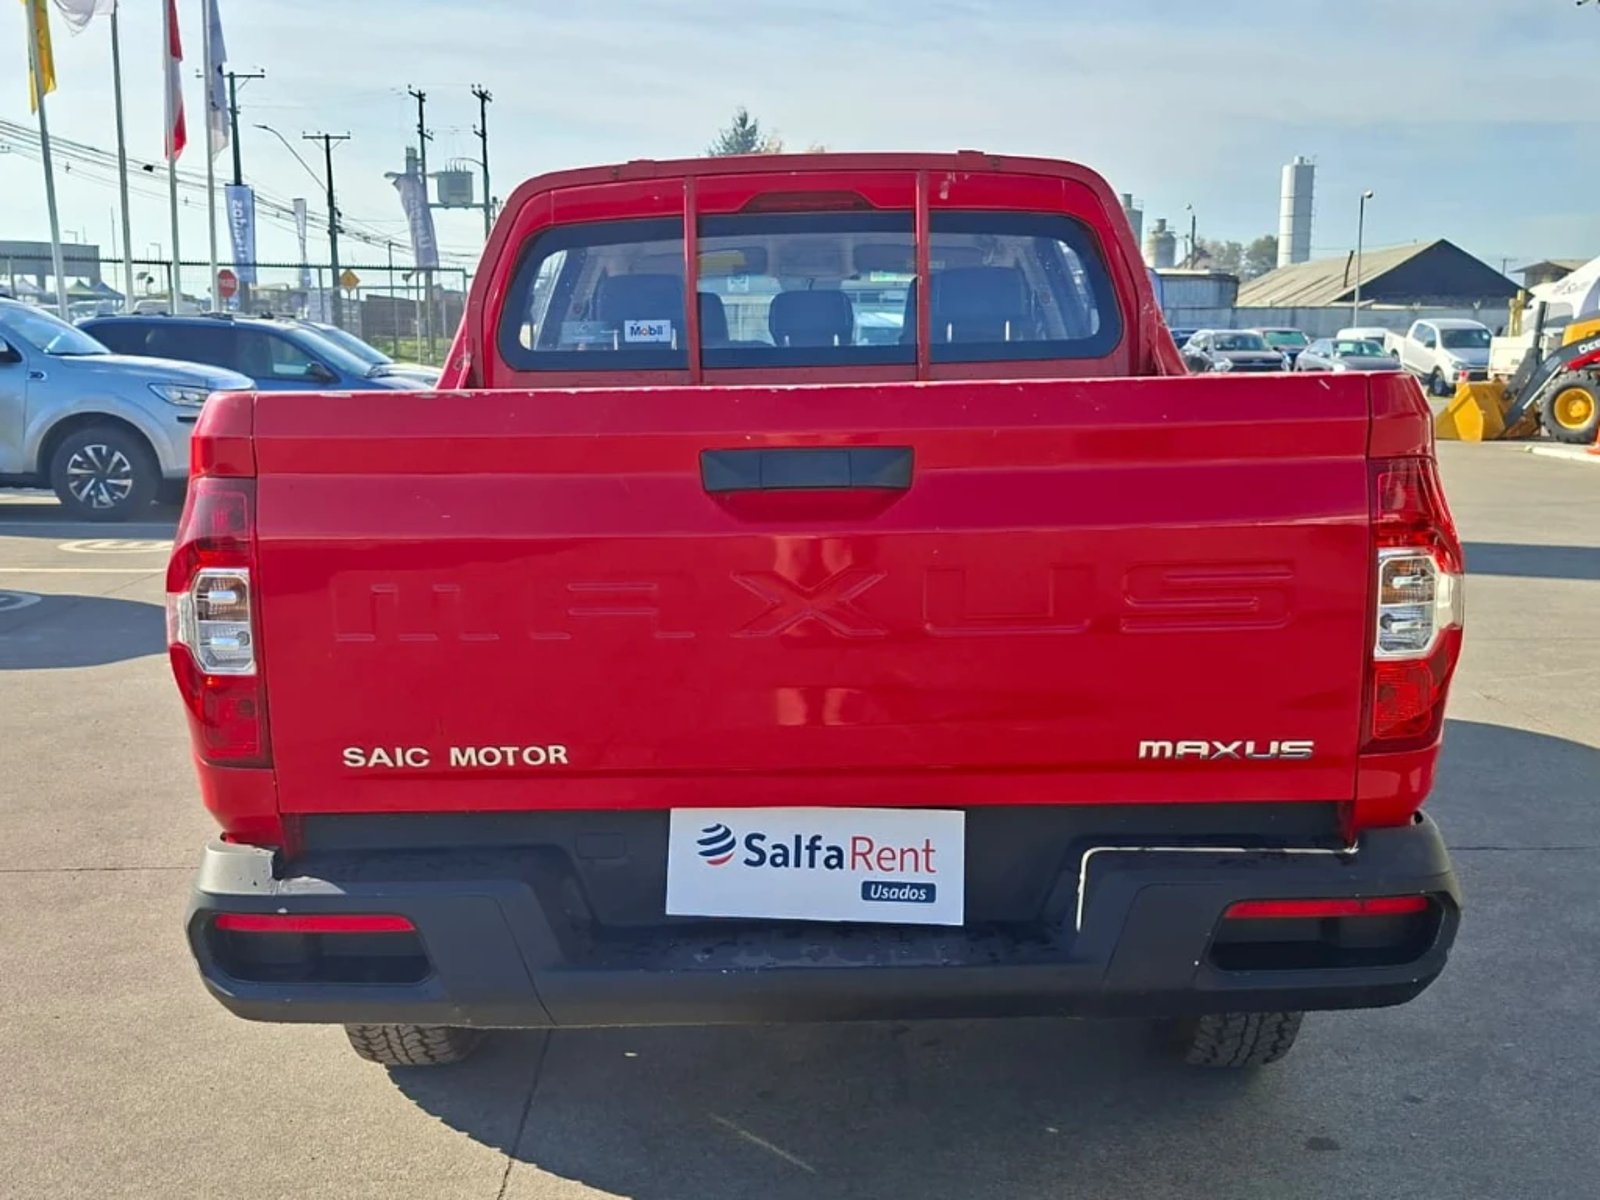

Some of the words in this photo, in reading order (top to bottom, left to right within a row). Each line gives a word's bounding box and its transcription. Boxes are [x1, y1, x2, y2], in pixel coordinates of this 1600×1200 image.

[630, 325, 663, 336] Mobil
[333, 562, 1295, 641] MAXUS
[341, 747, 430, 768] SAIC
[449, 745, 569, 767] MOTOR
[1138, 740, 1314, 760] MAXUS
[743, 832, 937, 873] SalfaRent
[870, 883, 927, 901] Usados
